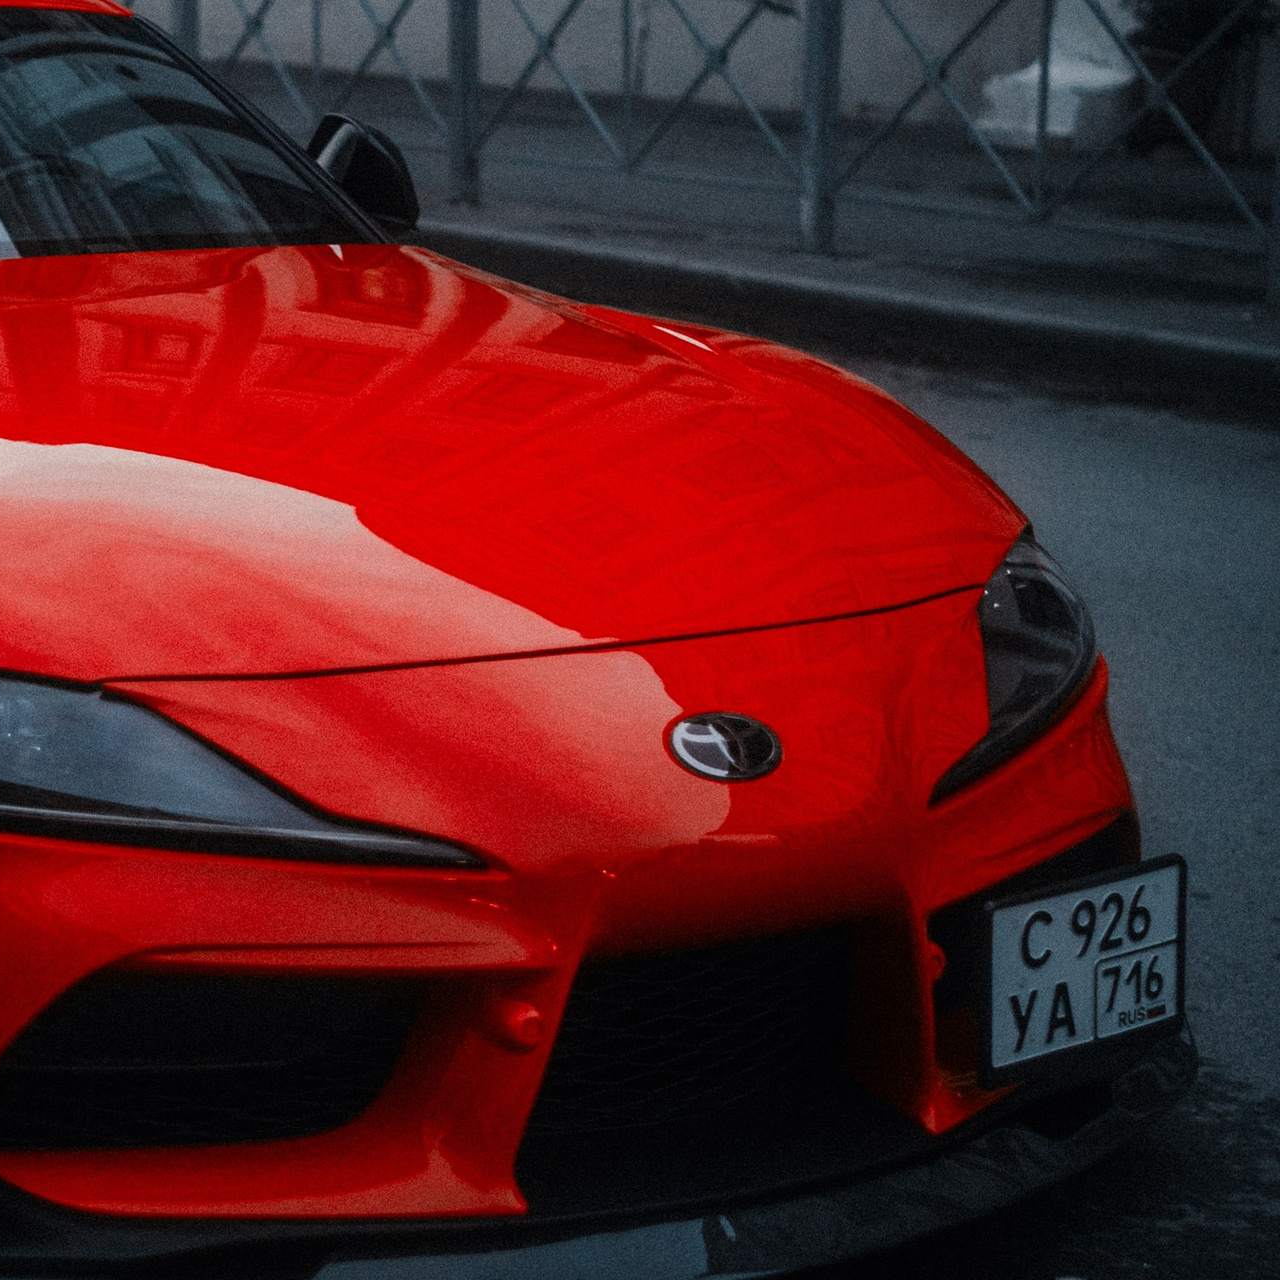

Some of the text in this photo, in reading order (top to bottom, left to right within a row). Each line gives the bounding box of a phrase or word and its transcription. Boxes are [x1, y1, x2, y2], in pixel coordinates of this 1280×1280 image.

[1071, 884, 1152, 959] 926
[1101, 955, 1163, 1013] 716
[1119, 1006, 1147, 1027] RUS
